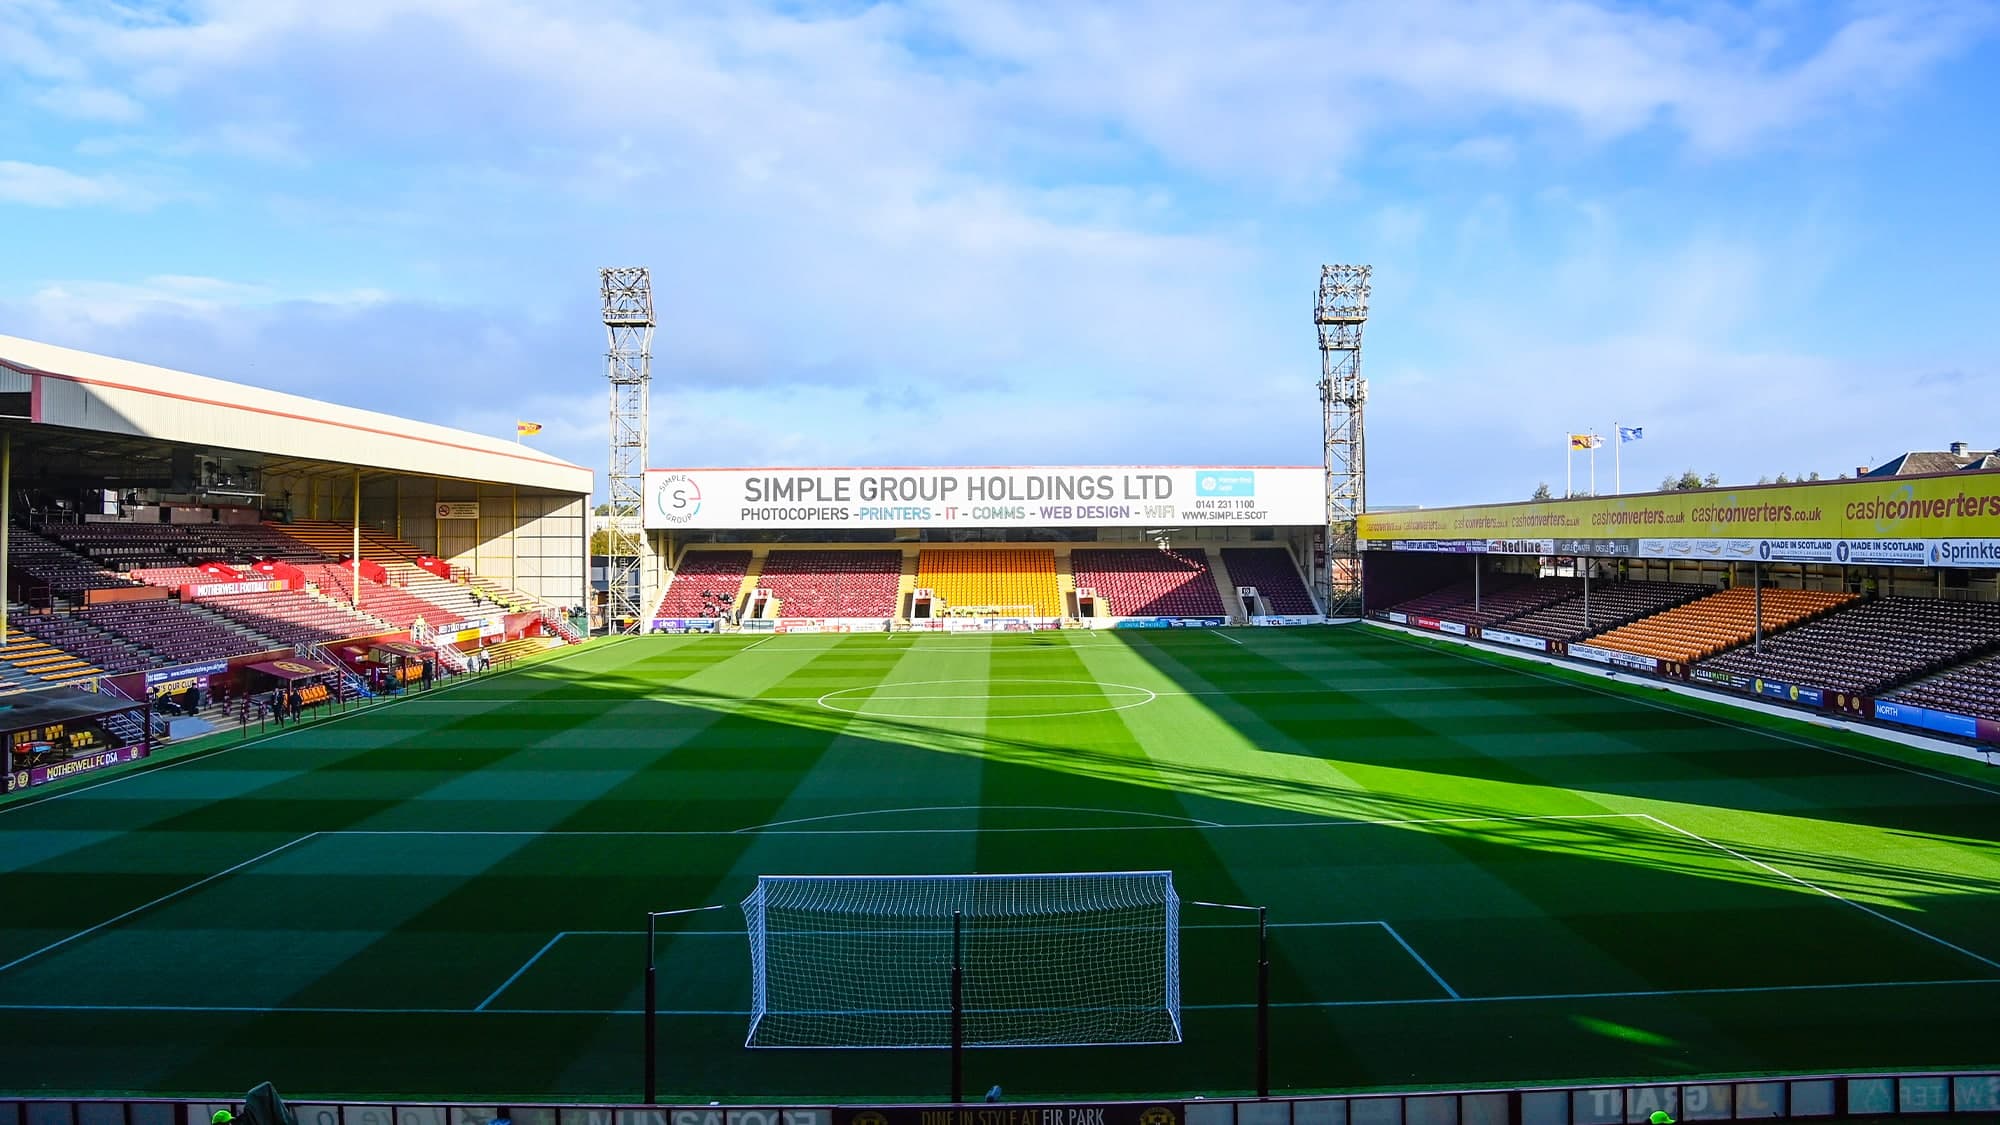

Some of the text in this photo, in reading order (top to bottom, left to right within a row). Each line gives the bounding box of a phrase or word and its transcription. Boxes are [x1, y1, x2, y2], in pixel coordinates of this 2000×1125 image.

[659, 474, 686, 492] SIMPLE
[744, 474, 1173, 502] SIMPLE GROUP HOLDINGS LTD
[672, 490, 687, 508] S
[1195, 500, 1255, 509] 0141 231 1100
[1846, 492, 2000, 520] cashconverters
[666, 513, 692, 524] GROUP
[741, 507, 849, 521] PHOTOCOPIERS
[945, 507, 958, 520] IT
[972, 506, 1025, 520] COMMS
[1039, 506, 1072, 519] WEB
[1077, 505, 1130, 519] DESIGN
[1144, 505, 1175, 519] WIFI
[1182, 511, 1268, 520] WWW.SIMPLE.SCOT
[1592, 506, 1685, 526] cashconverters.co.uk
[1691, 502, 1822, 523] cashconverters.co.uk
[1502, 540, 1541, 553] Redline
[1771, 541, 1832, 550] MADE IN SCOTLAND
[1850, 541, 1925, 551] MADE IN SCOTLAND
[198, 584, 239, 596] MOTHERWELL
[239, 582, 268, 593] FOOTBALL
[167, 682, 180, 691] OUR
[1876, 705, 1898, 718] NORTH
[47, 752, 118, 779] MOTHERWELL FC DSA
[1042, 1108, 1064, 1125] FIR
[1068, 1108, 1105, 1125] PARK
